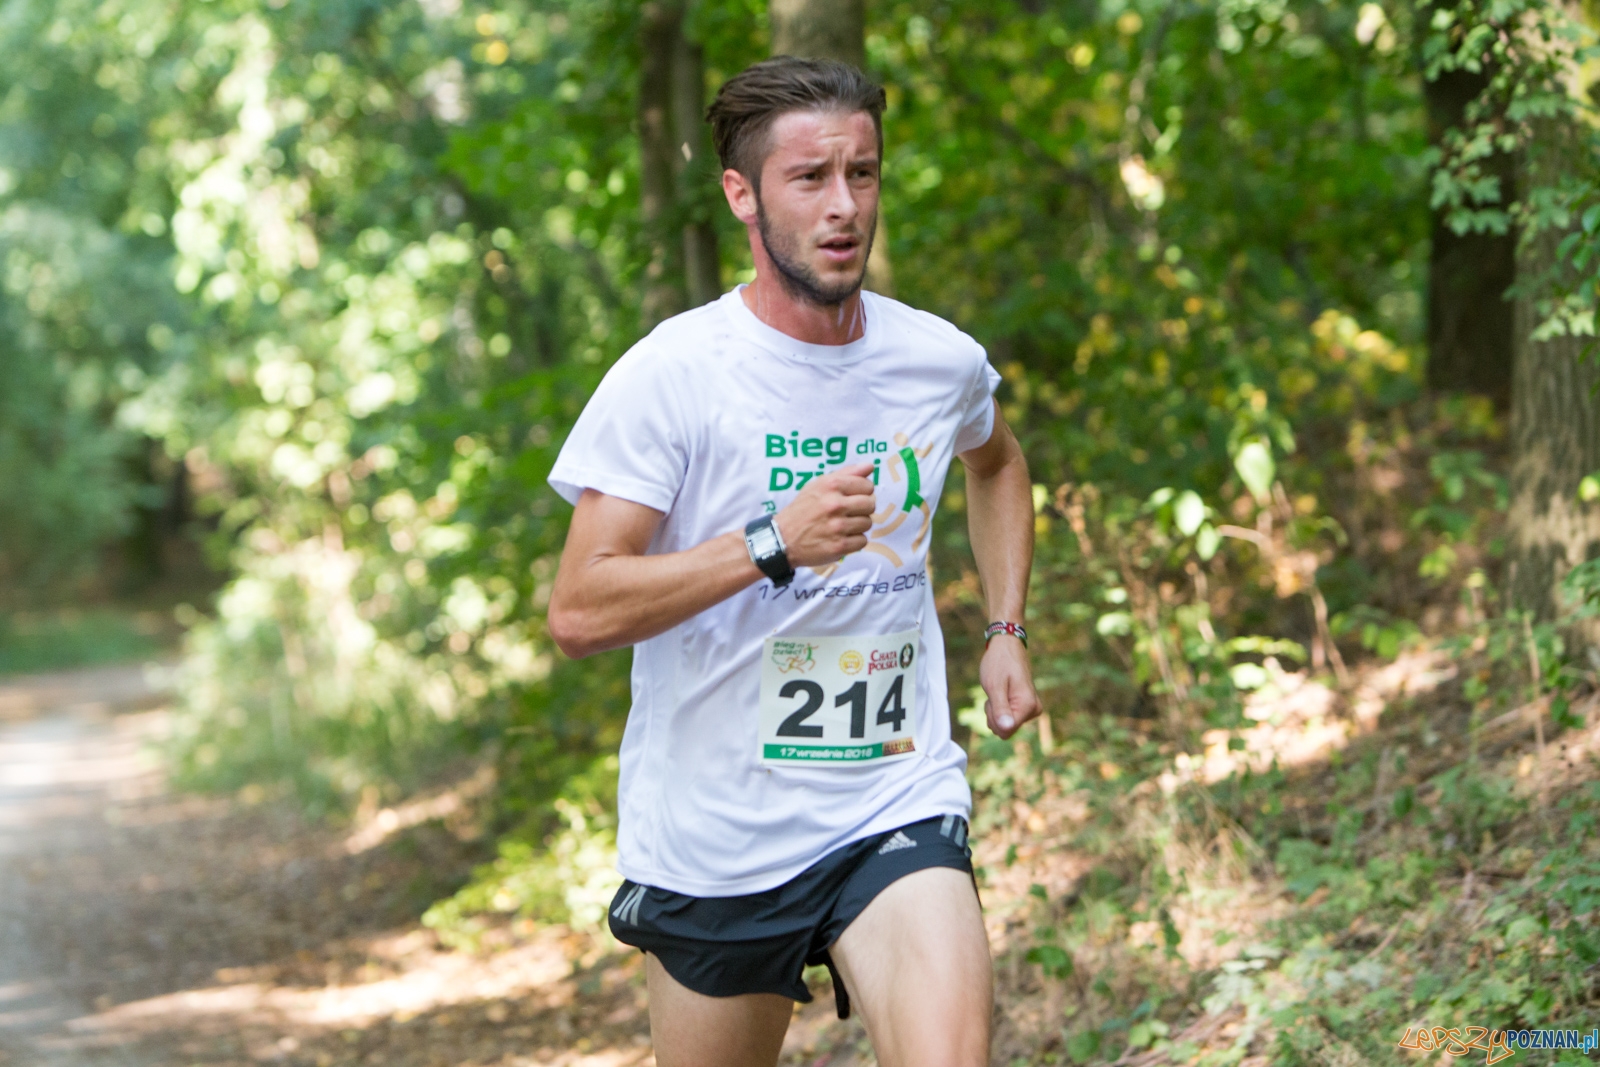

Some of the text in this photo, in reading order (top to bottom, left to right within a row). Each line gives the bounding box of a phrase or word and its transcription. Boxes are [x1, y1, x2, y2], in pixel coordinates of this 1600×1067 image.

[765, 430, 888, 465] Bieg dla
[768, 458, 881, 492] Dzii
[794, 579, 889, 600] września
[867, 660, 898, 675] POLSKA
[776, 674, 906, 739] 214
[780, 747, 797, 757] 17
